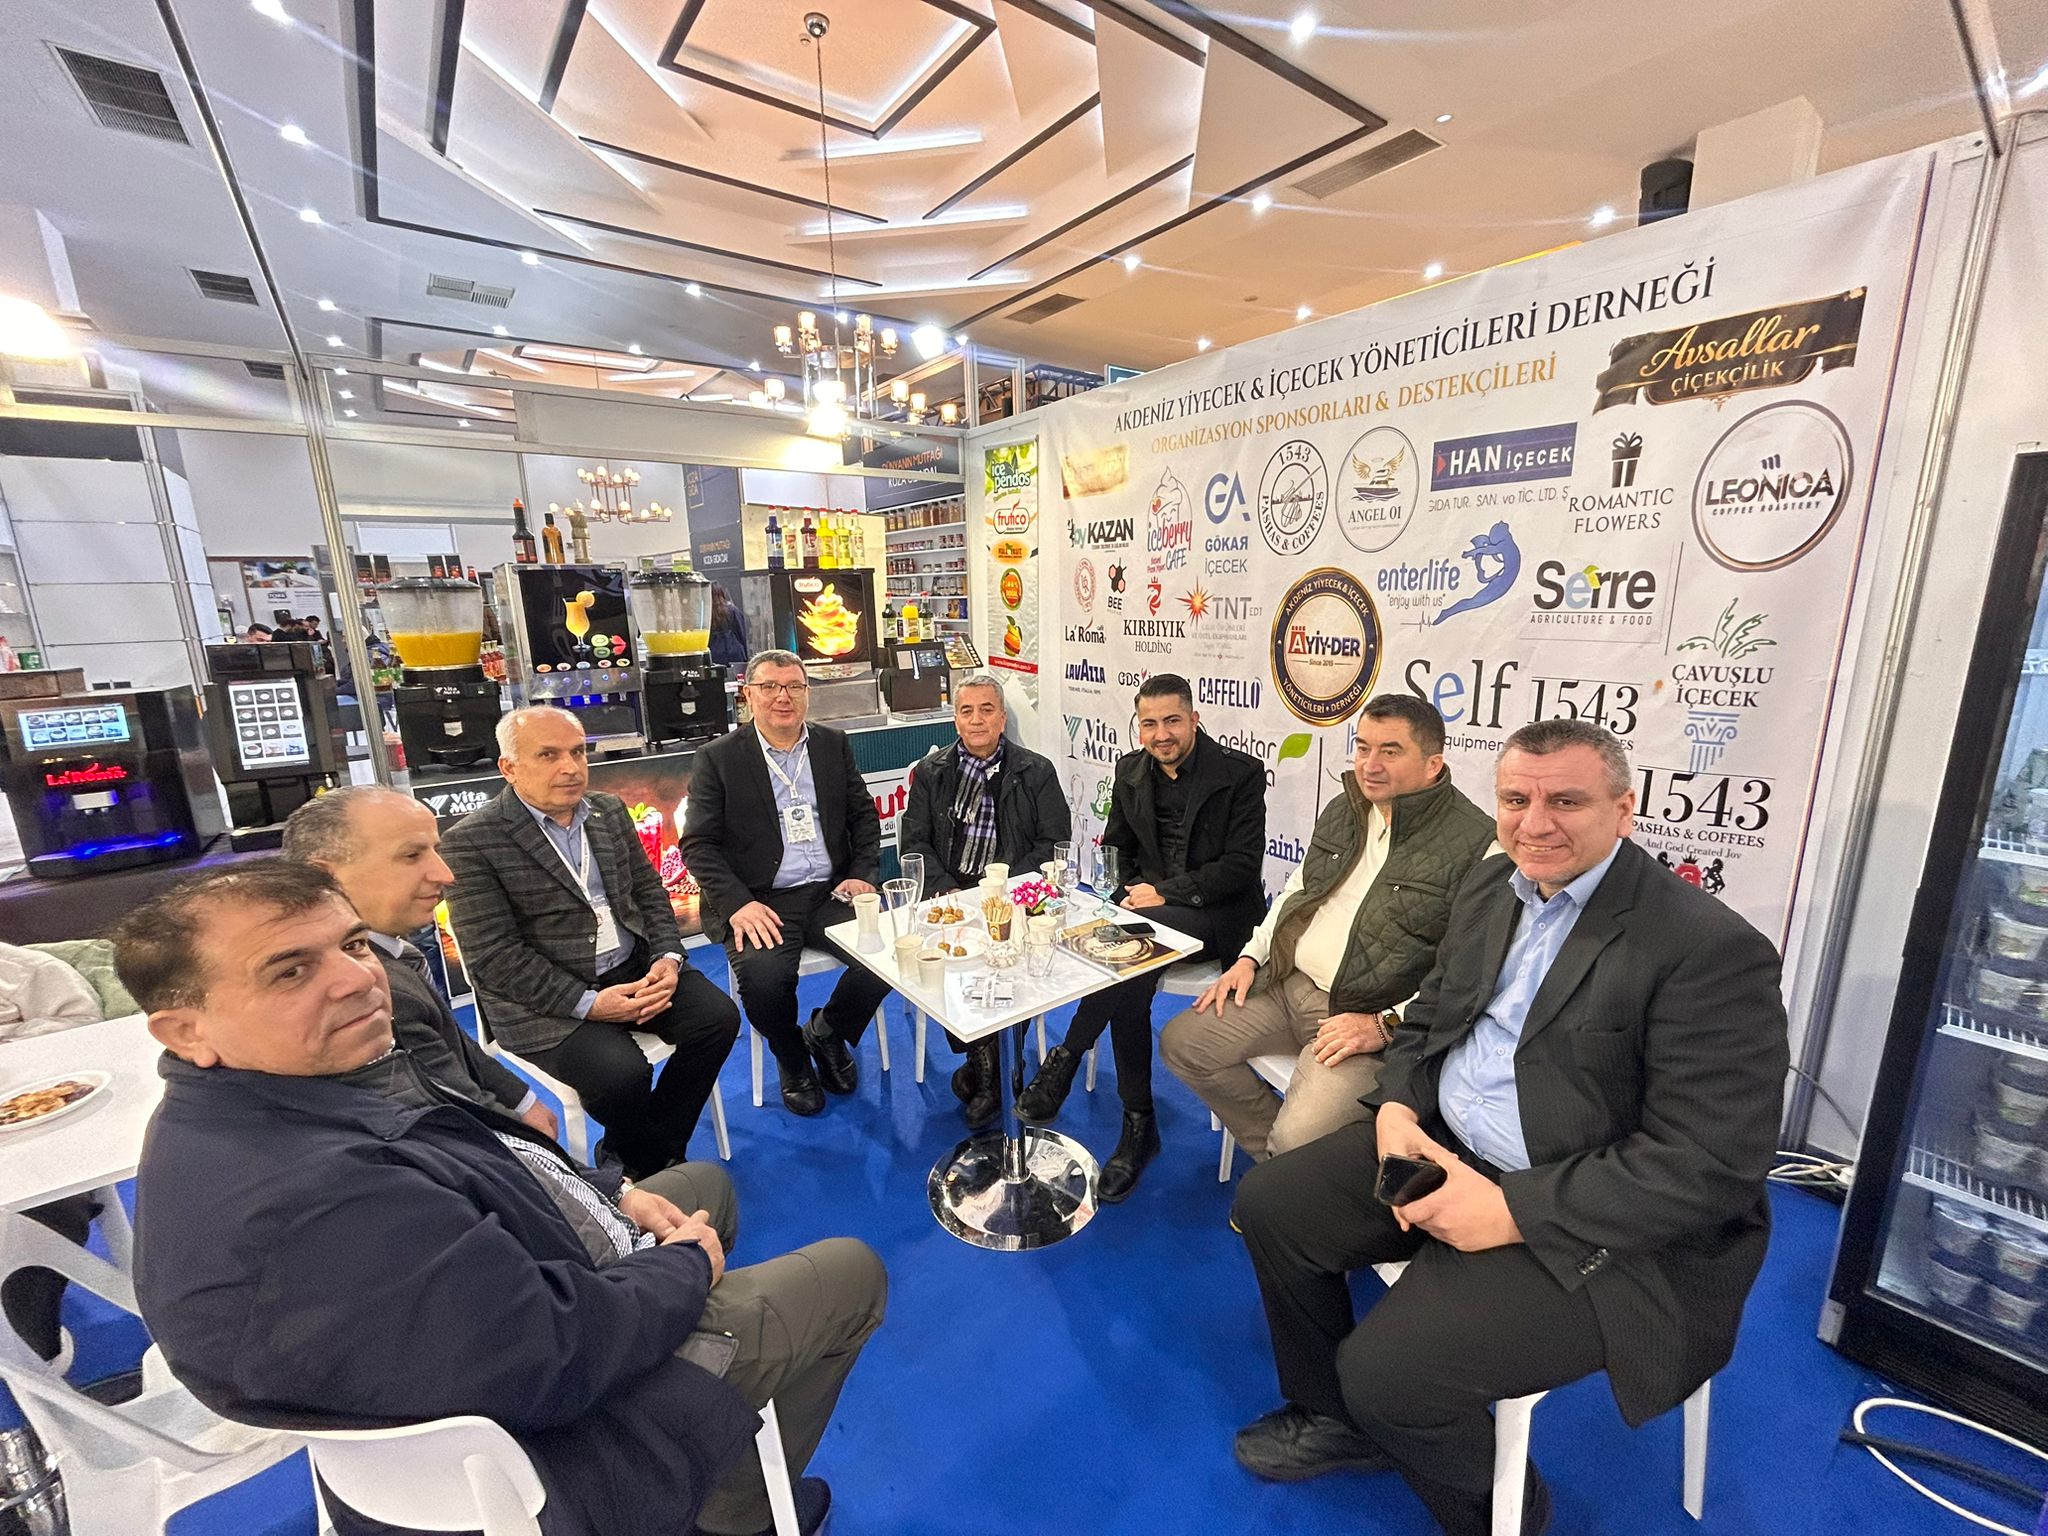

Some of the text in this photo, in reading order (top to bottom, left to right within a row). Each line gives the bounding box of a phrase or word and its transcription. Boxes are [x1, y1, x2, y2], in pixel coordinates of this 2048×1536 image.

[1114, 256, 1717, 434] AKDENİZ YİYECEK & İÇECEK YÖNETİCİLERİ DERNEĞİ
[1639, 314, 1820, 377] Avsallar
[1671, 360, 1784, 397] ÇİÇEKÇİLİK
[1152, 351, 1557, 454] ORGANİZASYON SPONSORLARI & DESTEKÇİLERİ
[1278, 444, 1311, 466] 1543
[1450, 444, 1573, 476] HAN İÇECEK
[991, 461, 1006, 477] ice
[994, 469, 1031, 493] pendos
[1568, 487, 1674, 512] ROMANTIC
[1705, 468, 1835, 506] LEONICA
[1262, 491, 1325, 550] PASHAS & COFFEES
[1349, 506, 1386, 523] ANGEL
[1712, 504, 1754, 516] COFFEE
[1087, 518, 1134, 544] KAZAN
[1574, 512, 1661, 534] FLOWERS
[1165, 548, 1187, 571] CAFE
[1204, 558, 1249, 578] İÇECEK
[1377, 558, 1461, 591] enterlife
[1533, 560, 1656, 610] Serre
[1108, 596, 1122, 611] BEE
[1212, 597, 1252, 619] TNT
[1285, 578, 1370, 617] AKDENİZ YİYECEK & İÇECEK
[1412, 593, 1431, 607] with
[1123, 620, 1186, 638] KIRBIYIK
[1530, 614, 1652, 626] AGRICULTURE & FOOD
[1135, 640, 1172, 654] HOLDİNG
[1065, 659, 1106, 684] LAVAZZA
[1672, 664, 1775, 688] ÇAVUŞLU
[1199, 676, 1262, 709] CAFFELLO
[1331, 683, 1362, 712] DERNEĞİ
[1404, 658, 1519, 729] Self
[1675, 684, 1760, 709] İÇECEK
[1527, 679, 1639, 735] 1543
[1086, 718, 1118, 745] Vita
[1443, 733, 1504, 752] quipmen
[1083, 737, 1123, 763] Mora
[449, 801, 486, 814] Mor
[450, 791, 487, 804] Vita
[1633, 768, 1772, 831] 1543
[1644, 838, 1663, 849] And
[1665, 841, 1684, 853] God
[1686, 845, 1723, 857] Created
[1683, 829, 1694, 840] &
[1698, 830, 1765, 848] COFFEES
